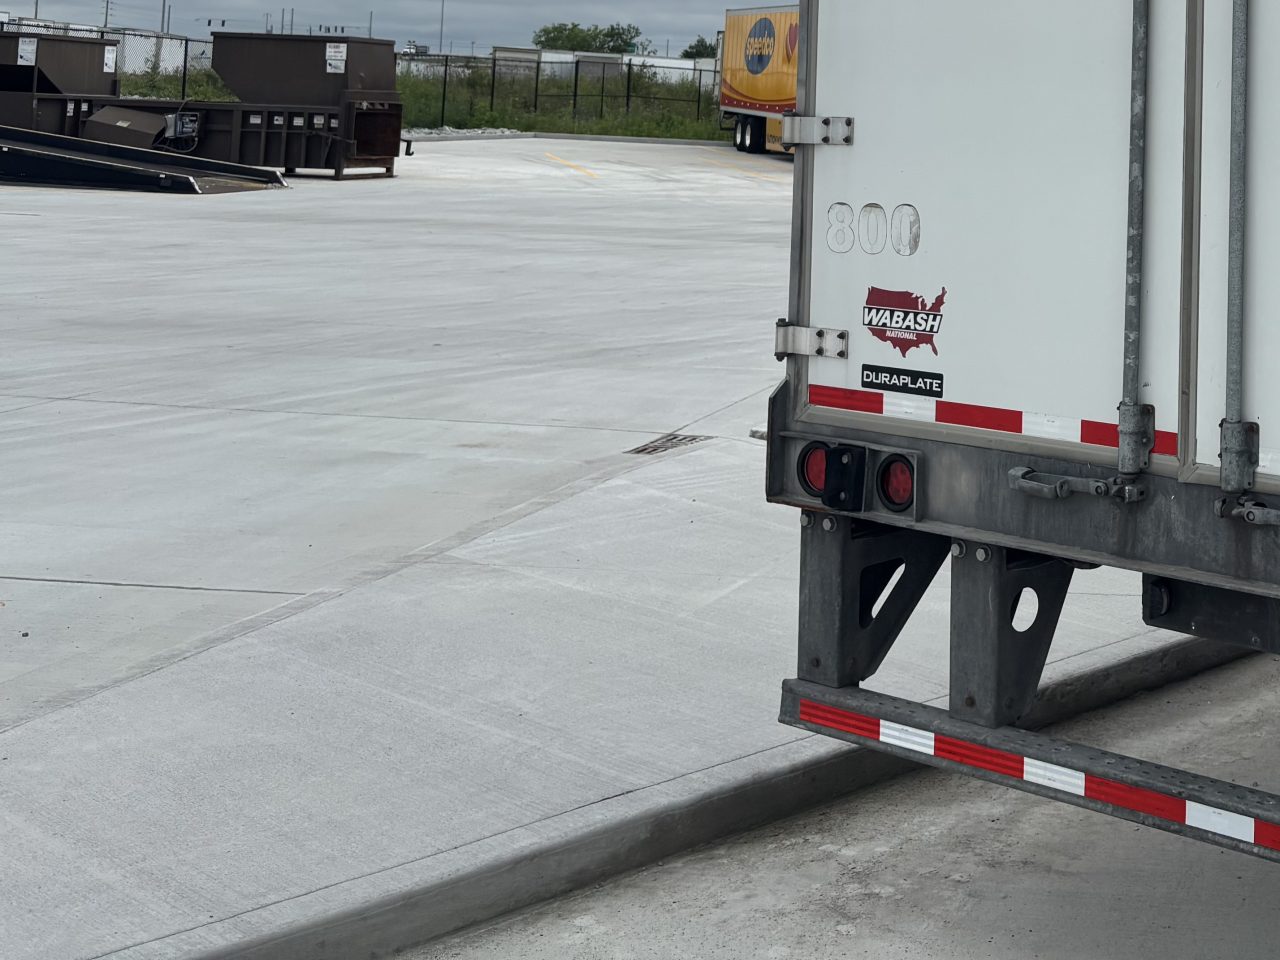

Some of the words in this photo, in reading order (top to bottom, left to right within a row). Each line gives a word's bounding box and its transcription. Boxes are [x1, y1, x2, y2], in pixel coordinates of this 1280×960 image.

[826, 202, 921, 256] 800
[864, 307, 942, 333] WABASH
[886, 329, 918, 340] NATIONAL
[864, 370, 942, 392] DURAPLATE
